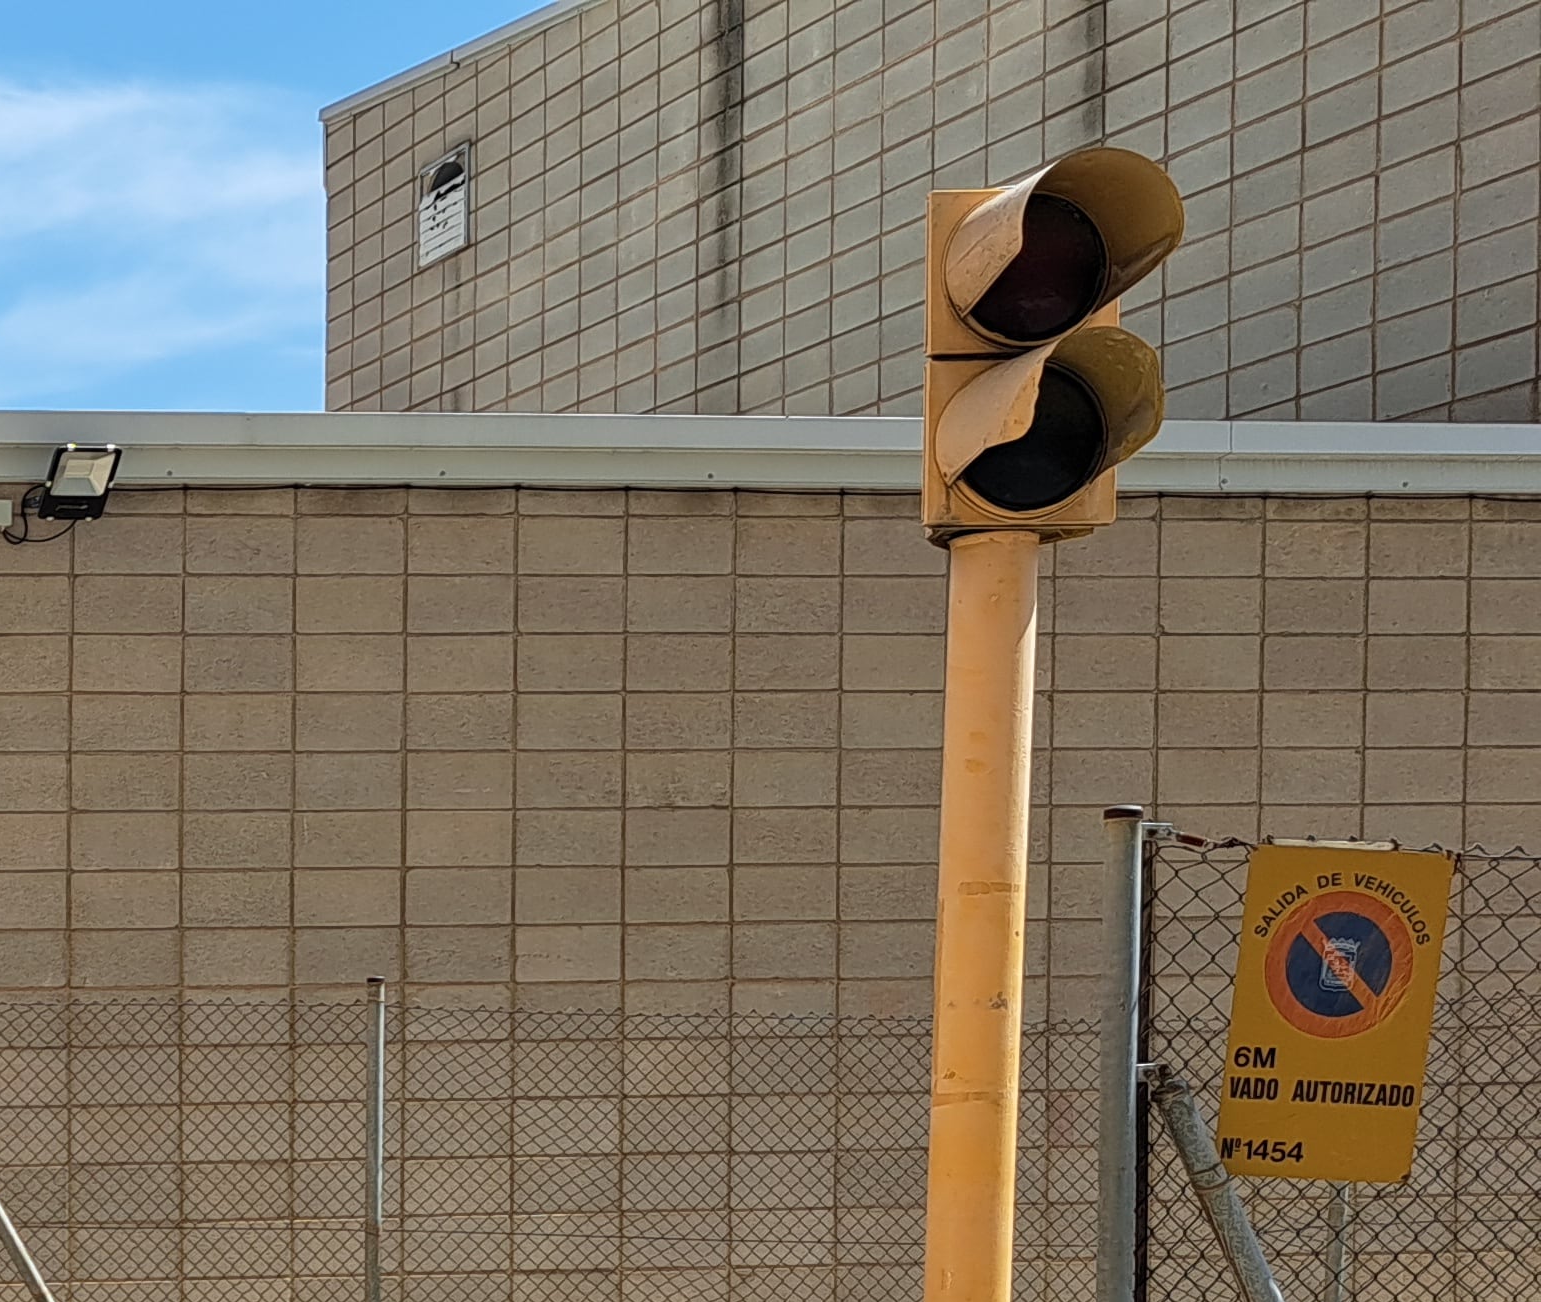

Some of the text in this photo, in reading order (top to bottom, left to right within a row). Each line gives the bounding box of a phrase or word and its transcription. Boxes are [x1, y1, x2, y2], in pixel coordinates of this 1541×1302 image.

[1254, 873, 1430, 946] SALIDA DE VEHICULOS
[1234, 1047, 1277, 1069] 6M
[1230, 1077, 1415, 1107] VADO AUTORIZADO
